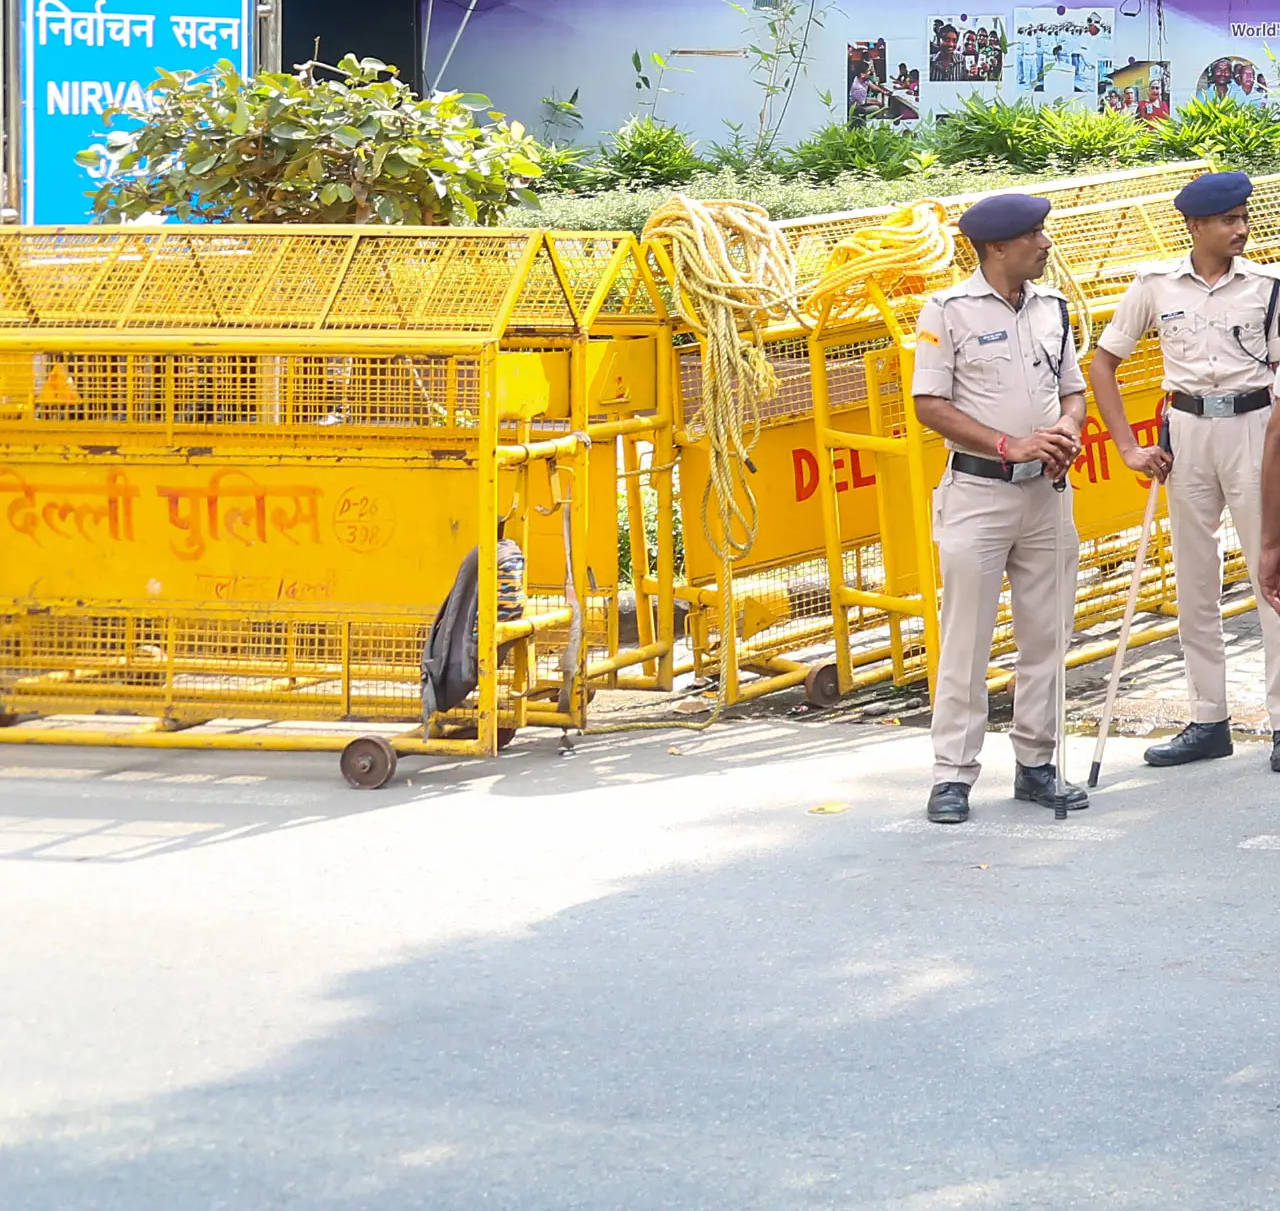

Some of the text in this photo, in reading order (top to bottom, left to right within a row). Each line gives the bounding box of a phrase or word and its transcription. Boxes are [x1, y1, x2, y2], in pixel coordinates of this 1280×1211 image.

[170, 15, 240, 50] सदन
[792, 447, 876, 503] DEL
[157, 467, 324, 562] पुलिस
